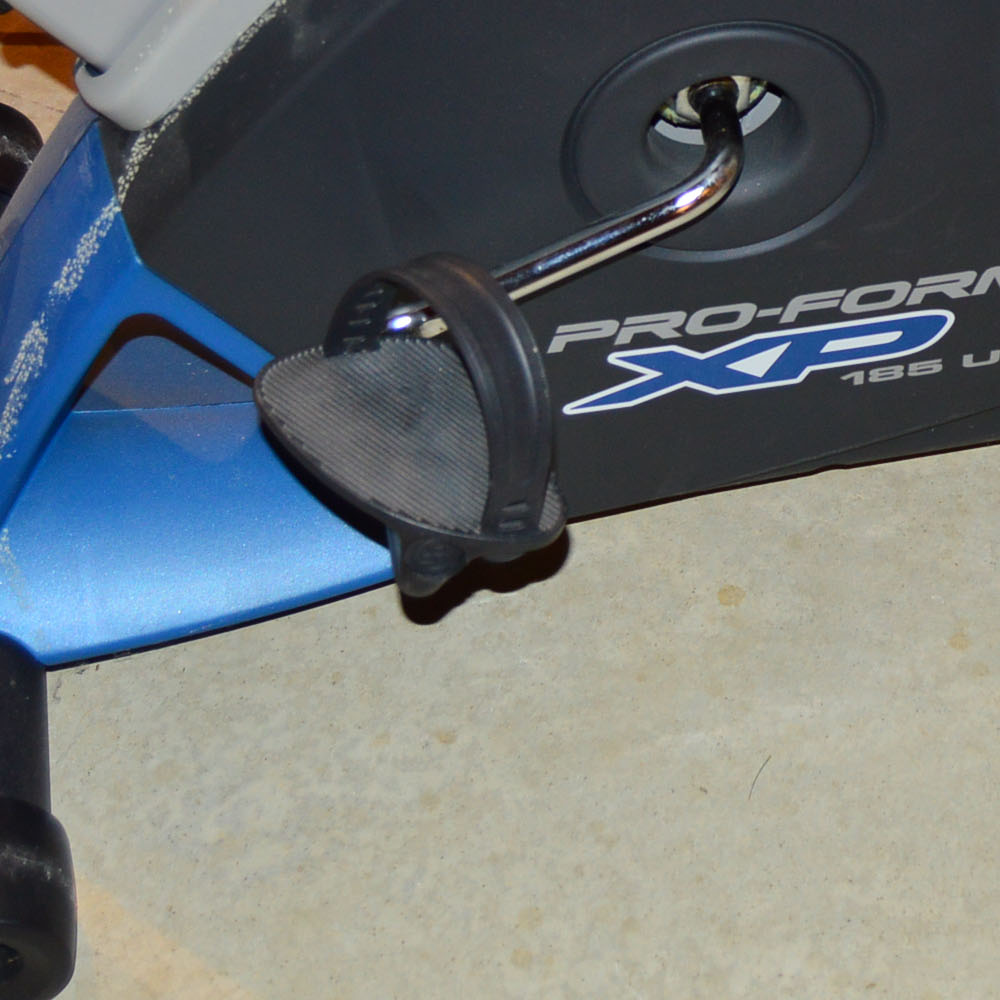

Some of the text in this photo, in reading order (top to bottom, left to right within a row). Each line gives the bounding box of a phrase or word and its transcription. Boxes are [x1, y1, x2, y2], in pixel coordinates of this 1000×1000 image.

[562, 309, 955, 415] XP
[840, 349, 1000, 386] 185 U
